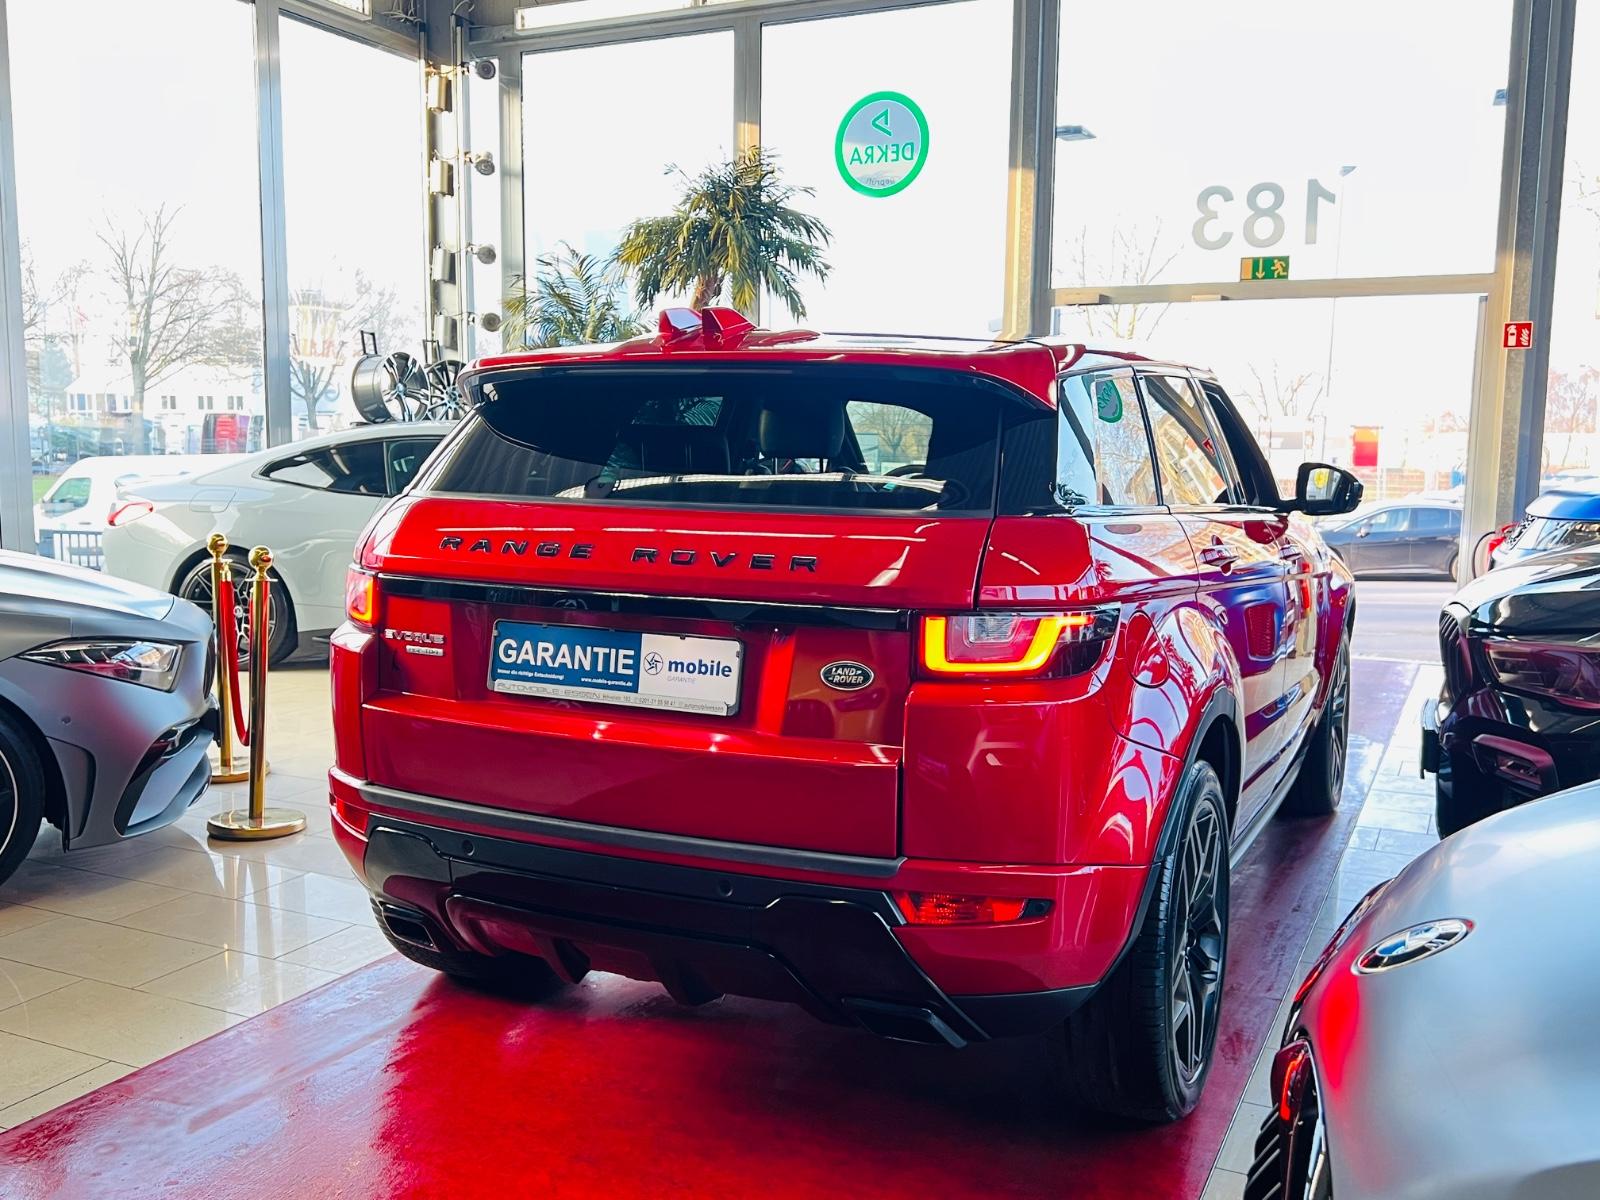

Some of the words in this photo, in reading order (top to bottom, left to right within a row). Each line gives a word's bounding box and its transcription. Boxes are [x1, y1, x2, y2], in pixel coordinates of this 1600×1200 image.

[439, 536, 595, 559] RANGE
[631, 547, 818, 573] ROVER
[498, 638, 635, 675] GARANTIE
[668, 658, 733, 678] mobile
[832, 667, 856, 675] LAND
[833, 675, 864, 684] ROVER
